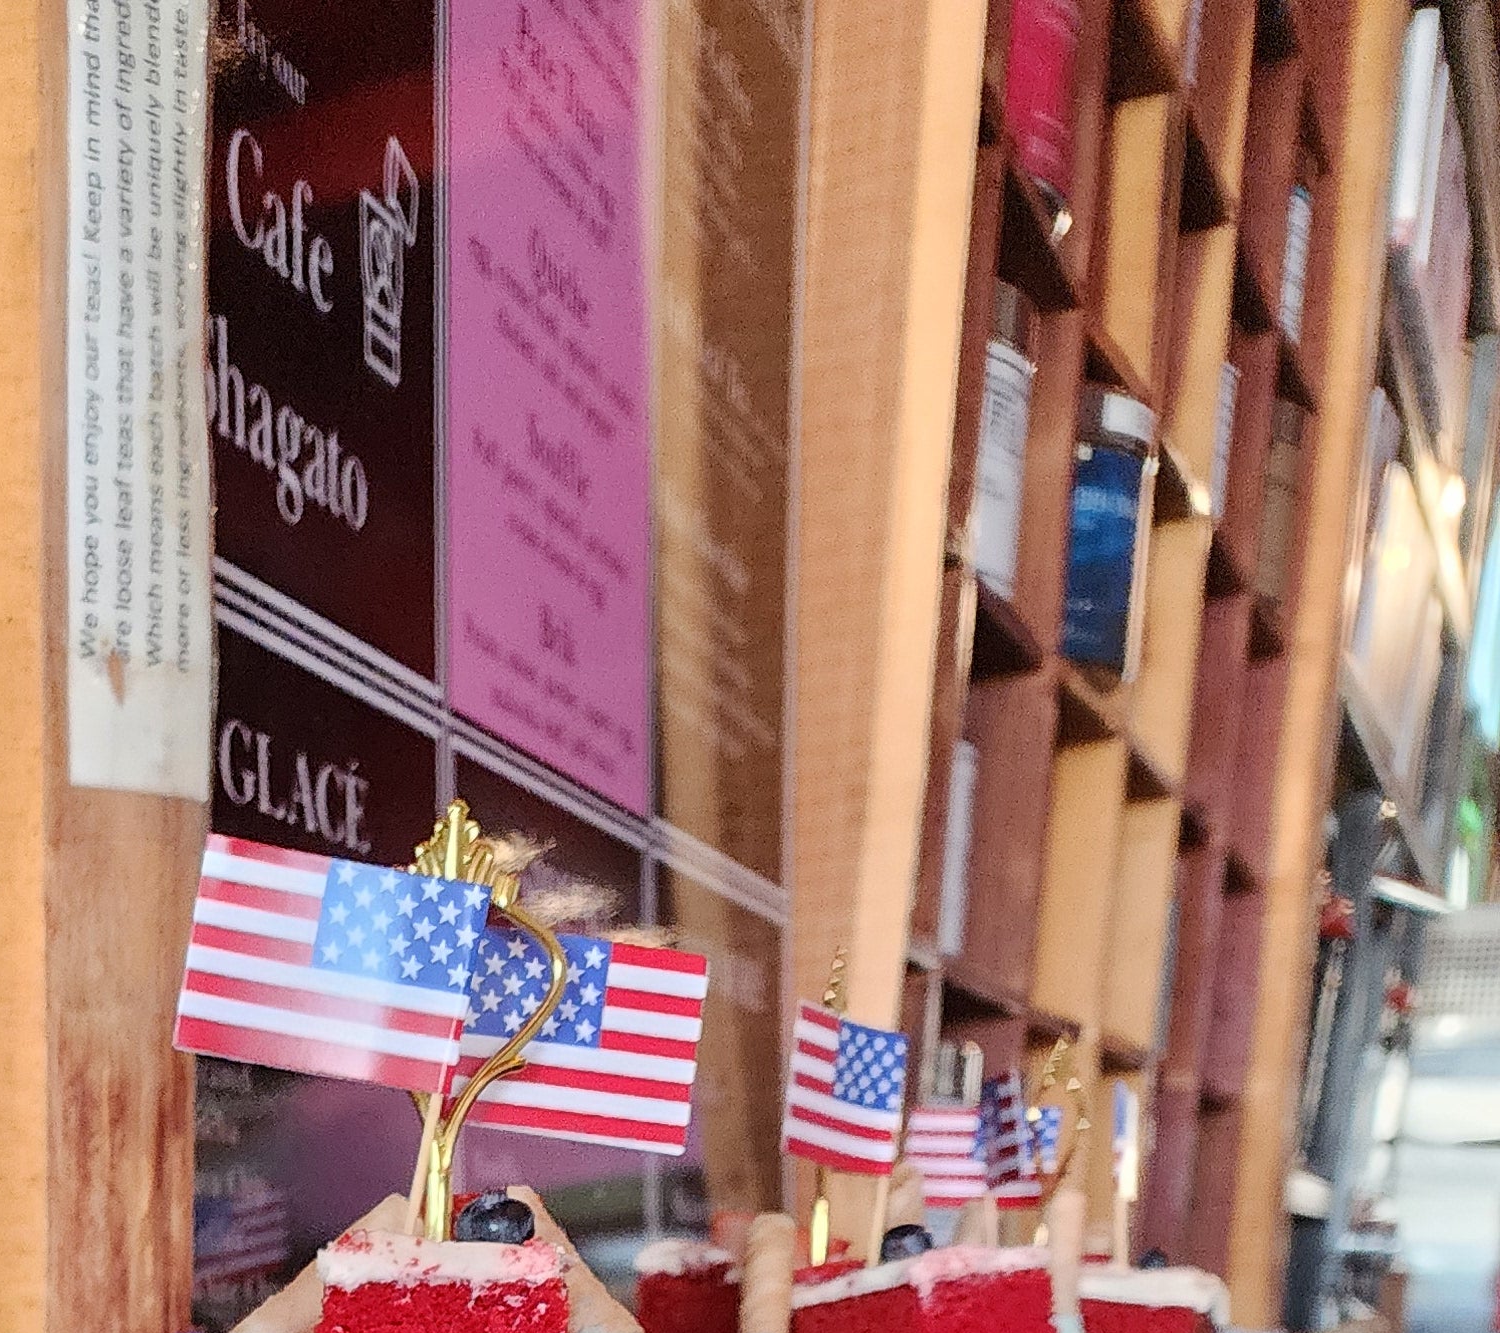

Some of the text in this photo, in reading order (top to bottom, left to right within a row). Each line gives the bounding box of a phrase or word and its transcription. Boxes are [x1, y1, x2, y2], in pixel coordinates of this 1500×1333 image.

[82, 51, 101, 127] mind
[113, 99, 134, 131] of
[171, 88, 188, 114] in
[82, 137, 101, 161] in
[144, 94, 166, 218] uniquely
[171, 120, 189, 221] slightly
[82, 171, 106, 244] Keep
[115, 138, 137, 238] variety
[145, 227, 163, 261] be
[227, 128, 336, 315] Cafe
[81, 253, 102, 323] teas!
[117, 247, 134, 263] a
[115, 272, 134, 338] have
[145, 269, 163, 317] will
[83, 333, 100, 382] our
[115, 347, 134, 405] that
[144, 326, 164, 402] batch
[82, 388, 104, 466] enjoy
[115, 413, 134, 470] teas
[145, 410, 164, 477] each
[83, 475, 103, 525] you
[113, 478, 134, 530] leaf
[147, 483, 165, 575] means
[175, 509, 192, 558] less
[80, 536, 107, 604] hope
[114, 539, 134, 611] loose
[175, 568, 192, 596] or
[78, 613, 100, 659] We
[144, 583, 164, 668] Which
[174, 602, 191, 674] more
